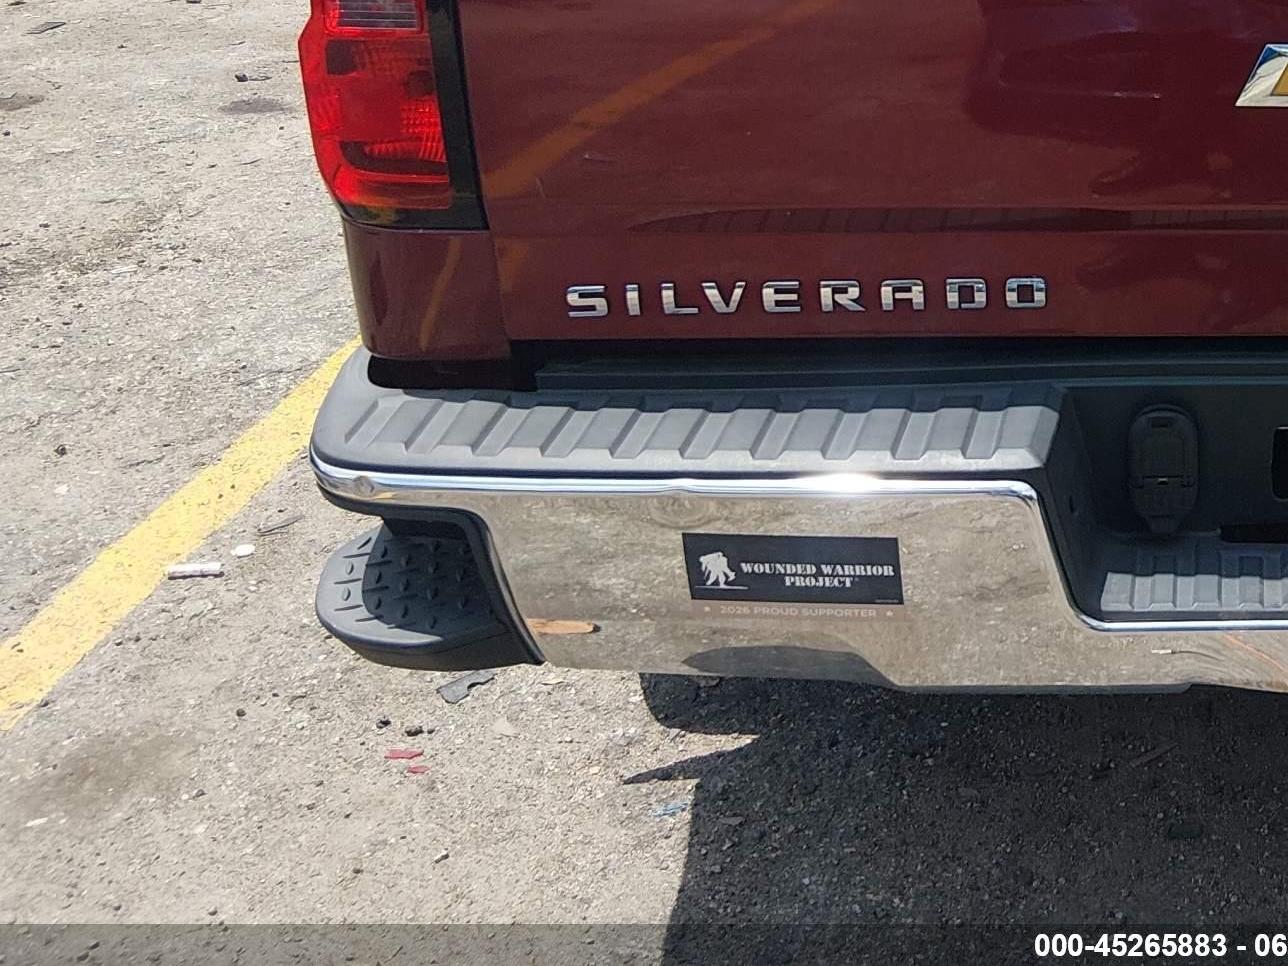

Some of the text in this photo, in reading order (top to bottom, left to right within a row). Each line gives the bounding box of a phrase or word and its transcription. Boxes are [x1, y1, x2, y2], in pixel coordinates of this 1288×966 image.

[566, 277, 1047, 318] SILVERADO
[740, 562, 895, 577] WOUNDED WARRIOR
[720, 605, 877, 618] 2026 PROUD SUPPORTER
